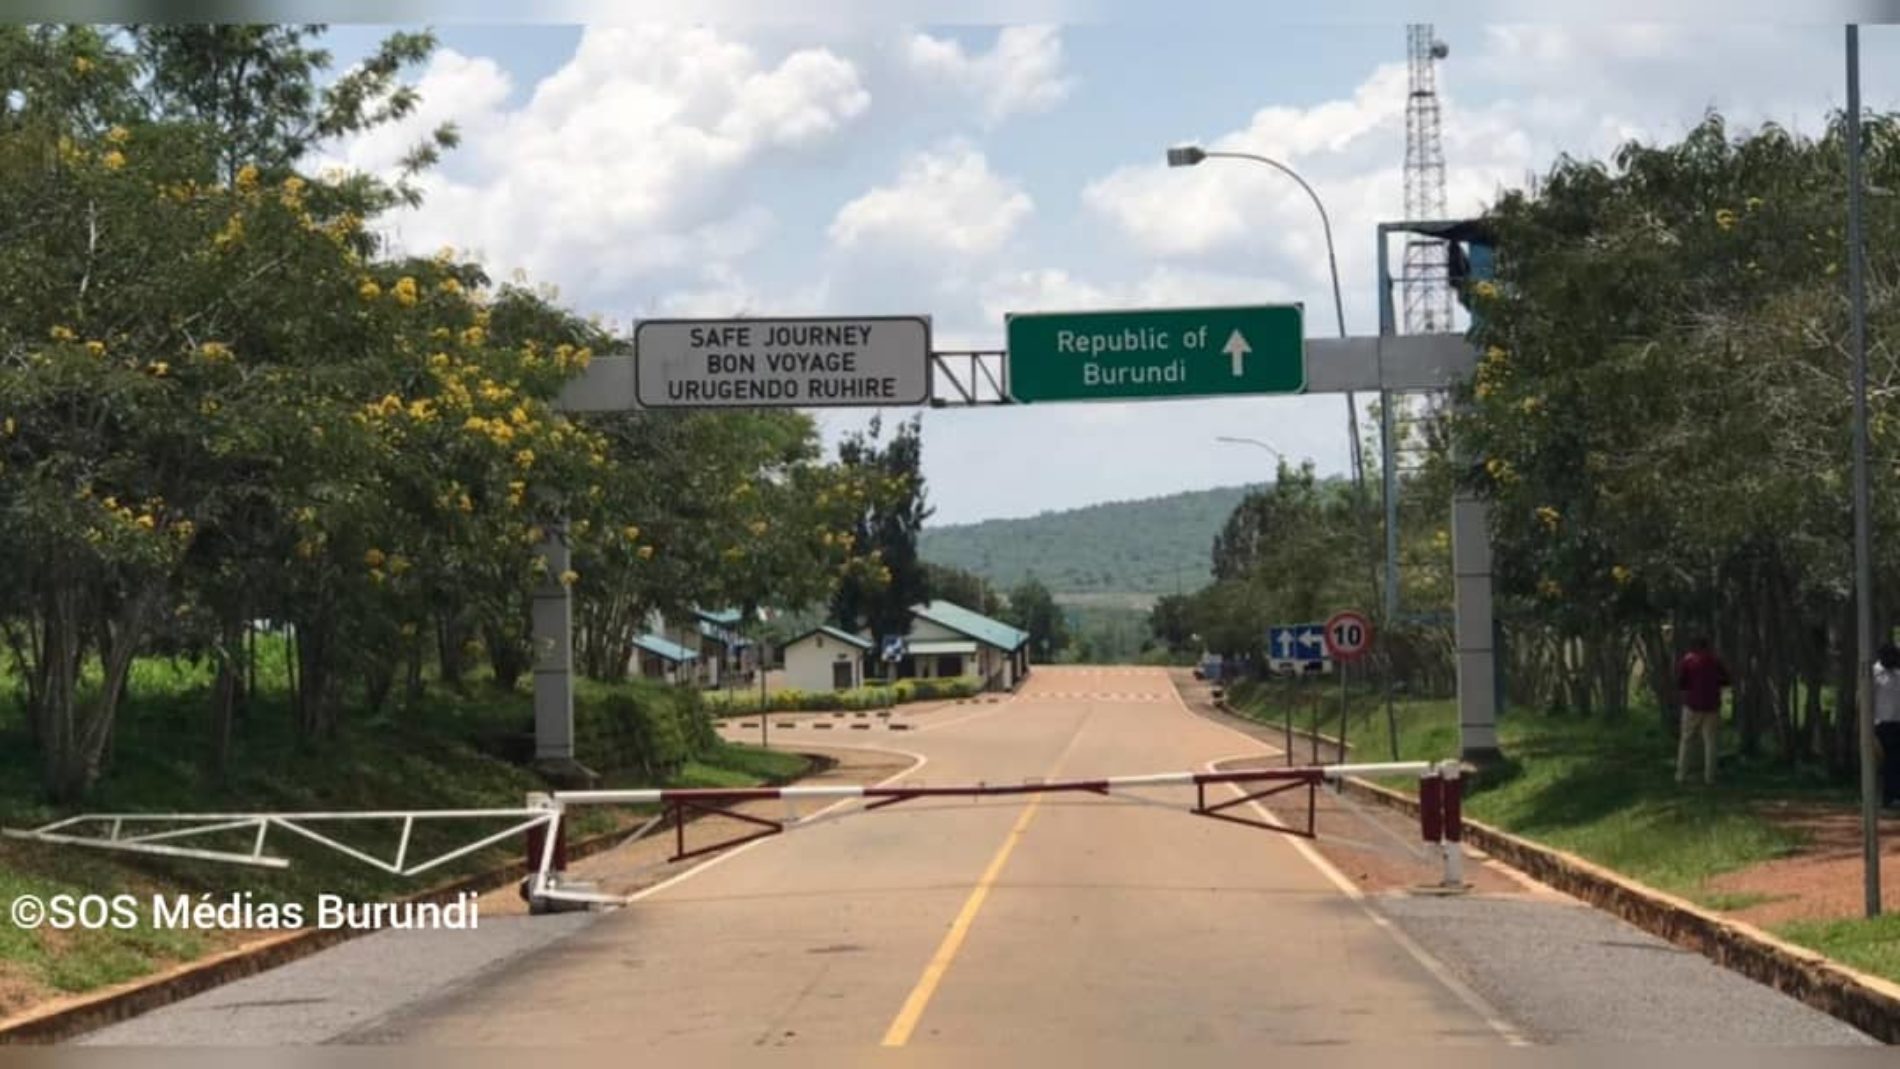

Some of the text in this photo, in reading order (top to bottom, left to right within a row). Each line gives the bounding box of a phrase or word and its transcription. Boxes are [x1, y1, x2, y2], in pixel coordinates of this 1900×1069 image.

[690, 325, 872, 348] SAFE JOURNEY
[1057, 326, 1208, 356] Republic of
[707, 352, 857, 374] BON VOYAGE
[1083, 360, 1186, 386] Burundi
[668, 378, 897, 400] URUGENDO RUHIRE
[1334, 624, 1360, 646] 10
